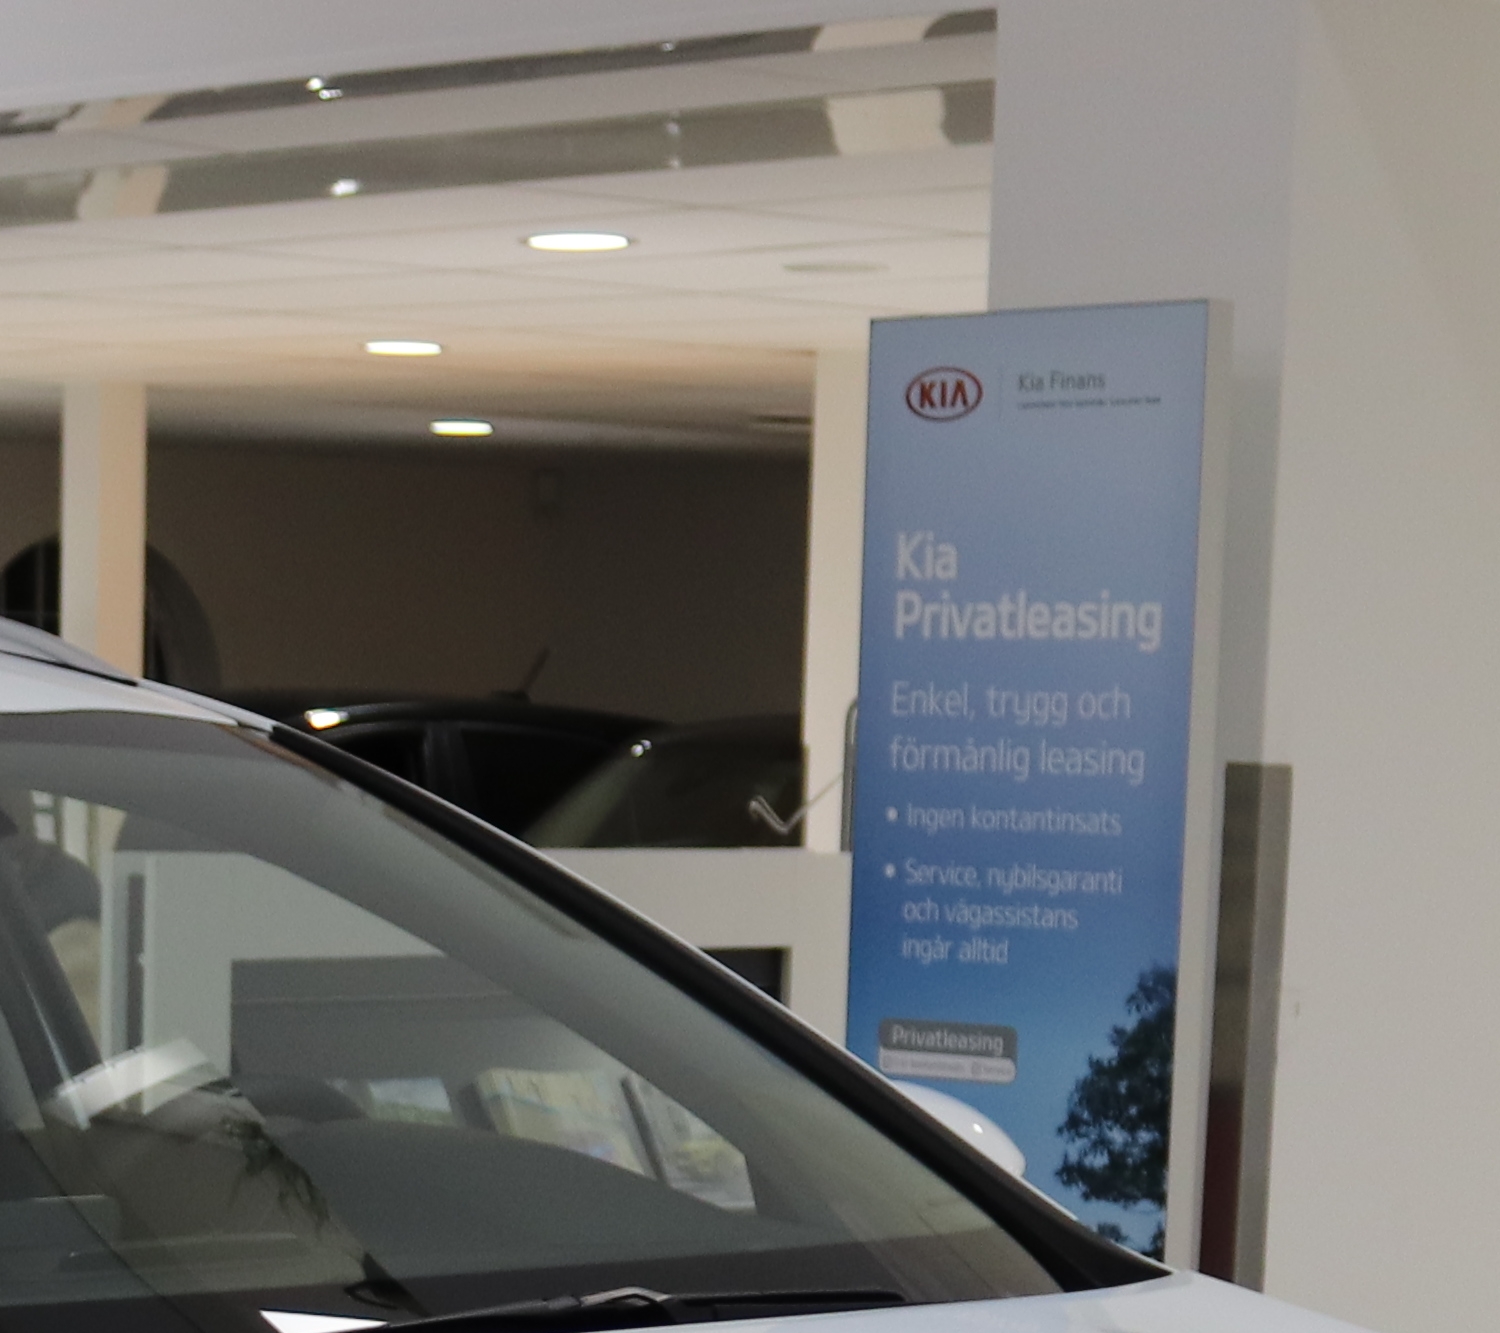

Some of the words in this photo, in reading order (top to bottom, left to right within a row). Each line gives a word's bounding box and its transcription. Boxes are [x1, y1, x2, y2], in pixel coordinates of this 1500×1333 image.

[920, 380, 968, 409] KIA
[1018, 373, 1045, 391] Kia
[897, 531, 958, 580] Kia
[895, 588, 1163, 652] Privatleasing
[891, 680, 975, 721] Enkel,
[987, 687, 1069, 726] trygg
[1077, 685, 1131, 721] och
[891, 735, 1031, 783] förmånlig
[1040, 738, 1146, 787] leasing
[907, 803, 965, 836] Ingen
[971, 805, 1123, 836] kontantinsats
[988, 862, 1123, 895] nybilsgaranti
[903, 898, 940, 923] och
[902, 933, 951, 966] ingår
[957, 935, 1009, 964] alltid
[891, 1024, 1004, 1058] Privatleasing
